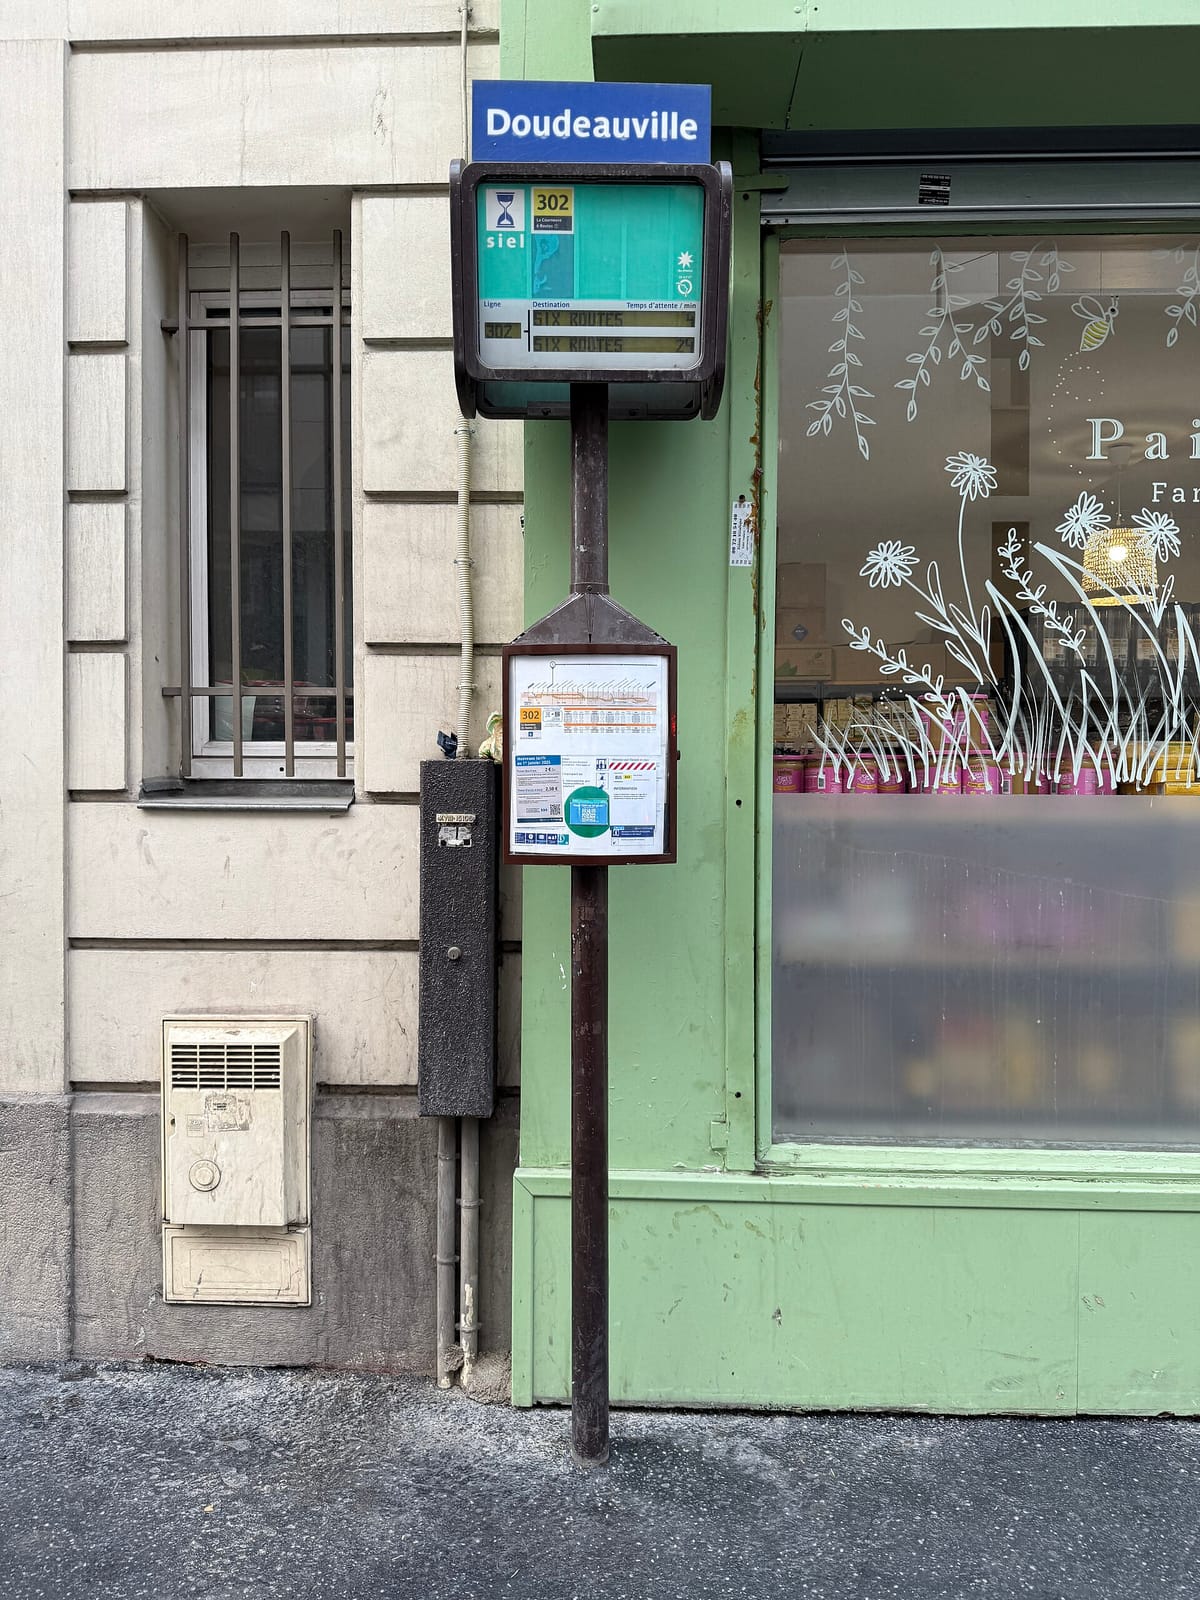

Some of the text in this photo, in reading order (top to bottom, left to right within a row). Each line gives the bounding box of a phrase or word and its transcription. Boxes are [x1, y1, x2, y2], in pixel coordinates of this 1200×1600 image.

[487, 108, 698, 140] Doudeauville
[537, 194, 569, 211] 302
[487, 233, 525, 248] siel
[533, 311, 560, 326] SIX
[569, 311, 623, 326] ROUTES
[485, 323, 513, 339] 302
[533, 337, 560, 352] SIX
[569, 337, 623, 352] ROUTES
[522, 710, 540, 720] 302
